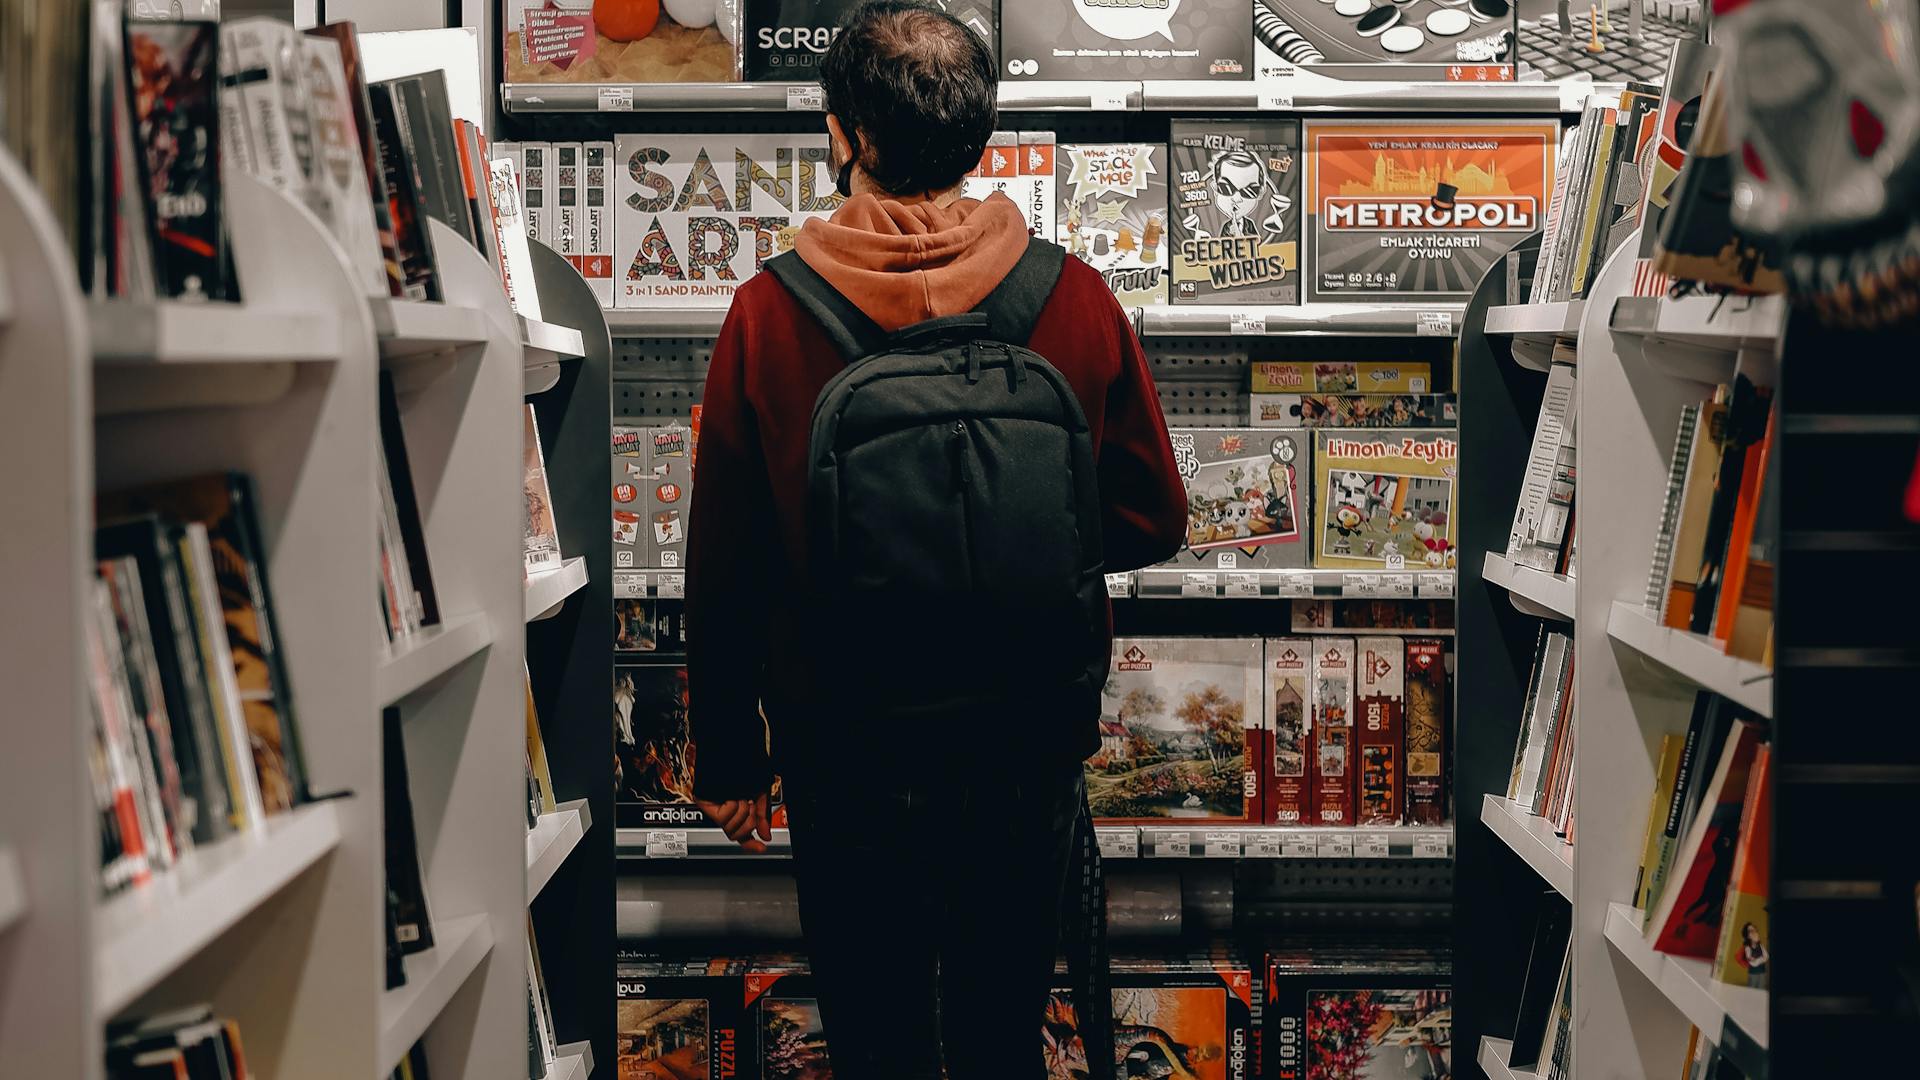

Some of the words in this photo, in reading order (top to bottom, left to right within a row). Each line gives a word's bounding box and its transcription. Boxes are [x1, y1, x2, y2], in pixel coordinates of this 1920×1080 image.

[1090, 156, 1133, 172] STACK
[625, 147, 846, 213] SAND
[1180, 170, 1201, 184] 720
[1034, 179, 1043, 212] SAND
[562, 208, 571, 227] ART
[590, 208, 598, 227] ART
[1034, 214, 1043, 236] ART
[1328, 203, 1529, 228] METROPOL
[590, 228, 598, 253] SAND
[626, 215, 790, 281] ART
[1183, 237, 1260, 263] SECRET
[1380, 236, 1422, 248] EMLAK
[1425, 234, 1481, 248] TİCARETİ
[1408, 249, 1452, 260] OYUNU
[1111, 267, 1161, 293] FUN!
[1209, 256, 1285, 287] WORDS
[1348, 272, 1363, 283] 60
[626, 285, 633, 296] 3
[647, 285, 652, 296] 1
[654, 285, 688, 296] SAND
[690, 285, 739, 296] PAINTIN
[1180, 283, 1195, 292] KS
[1327, 438, 1386, 458] Limon
[1367, 702, 1381, 731] 1500
[1244, 769, 1257, 798] 1500
[1277, 810, 1300, 821] 1500
[1319, 810, 1343, 821] 1500
[1280, 1016, 1296, 1067] 1000
[720, 1029, 736, 1080] PUZZL
